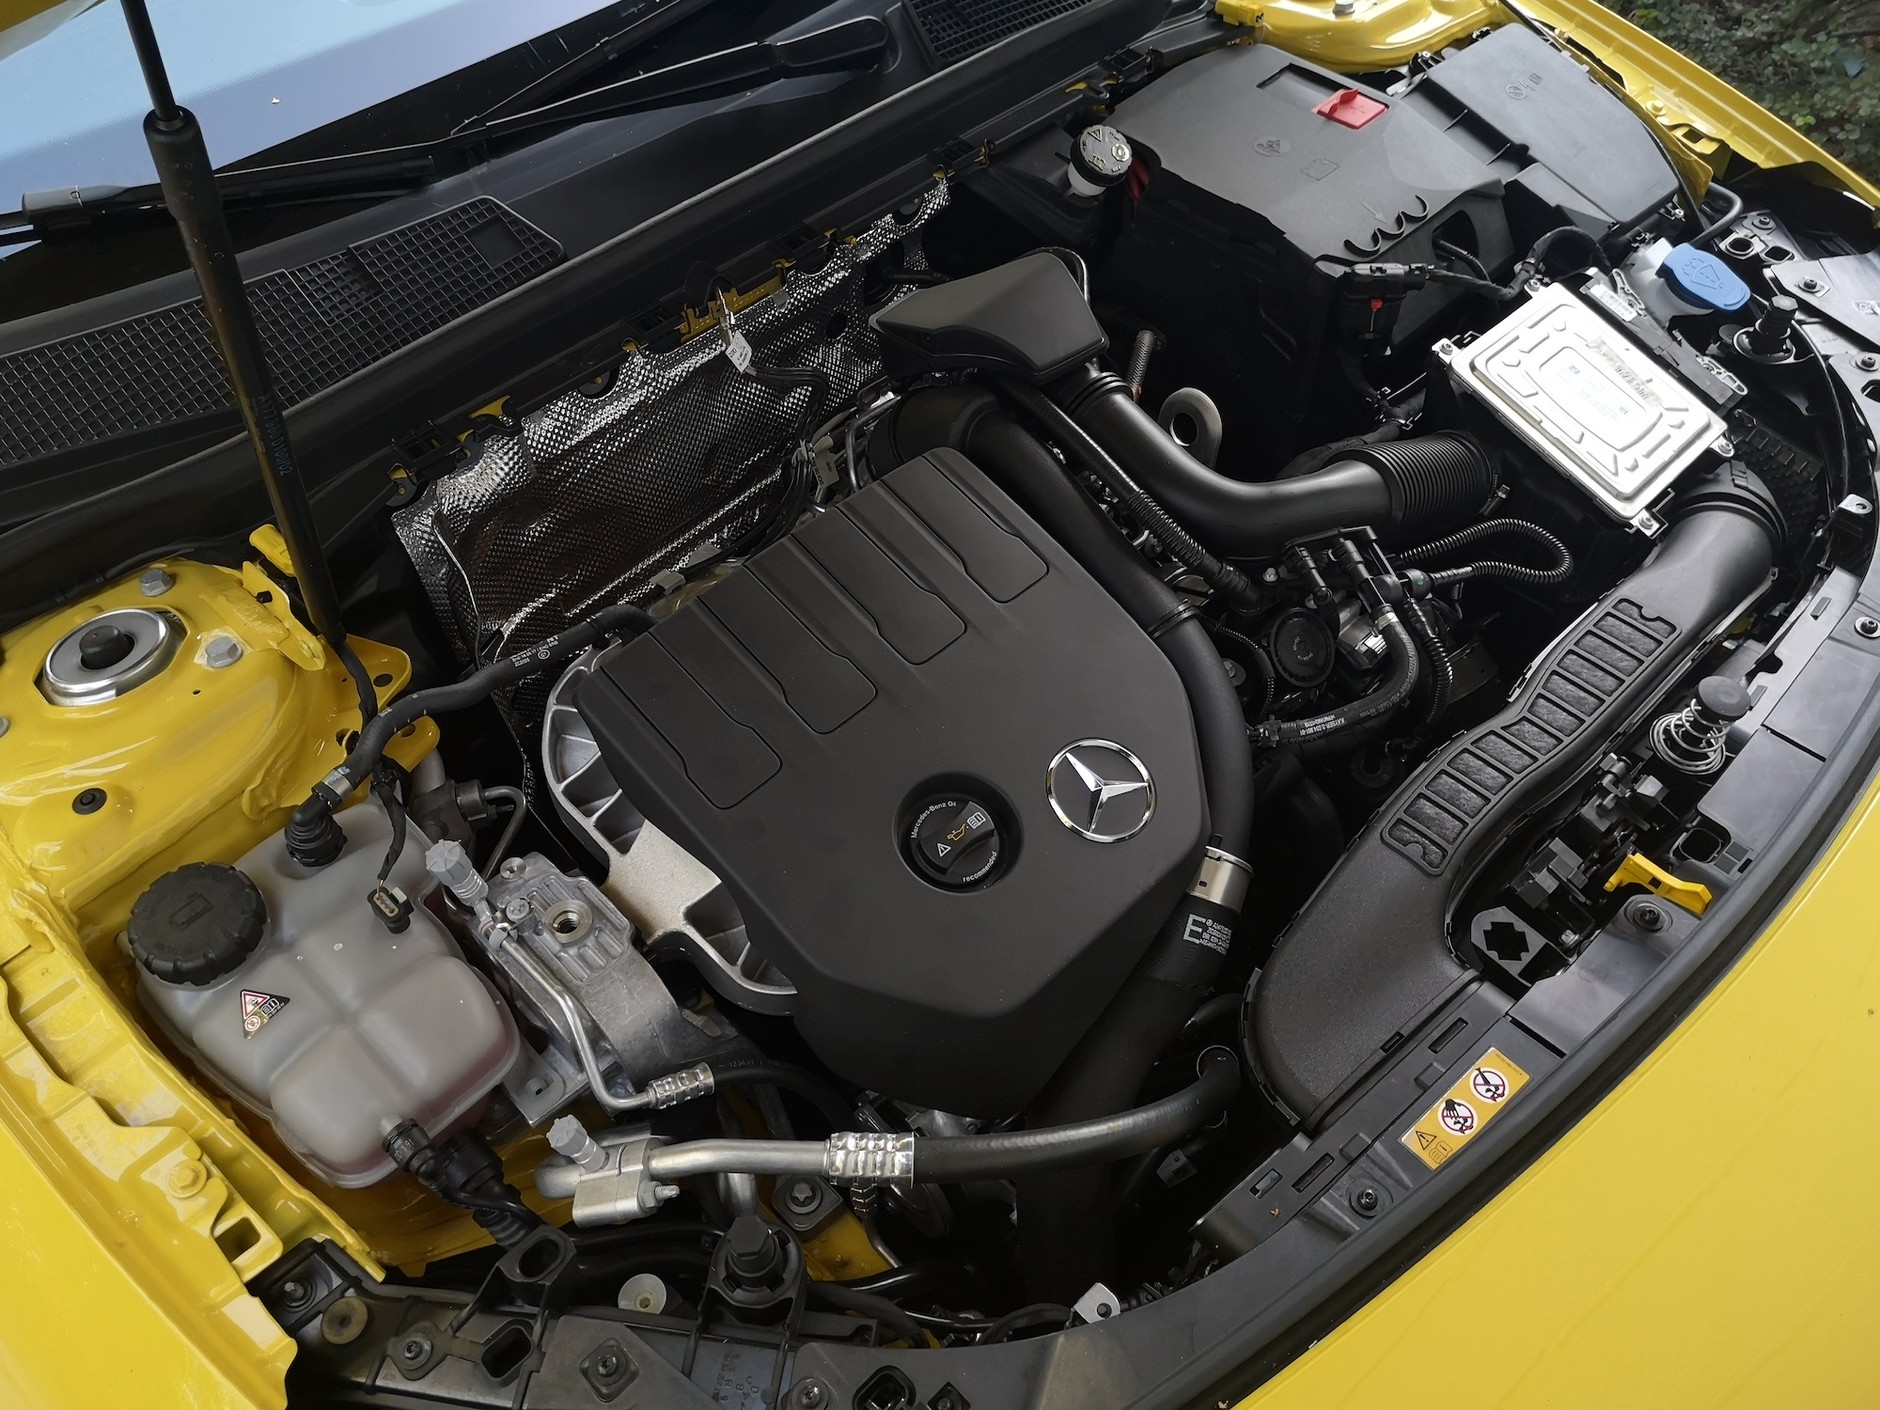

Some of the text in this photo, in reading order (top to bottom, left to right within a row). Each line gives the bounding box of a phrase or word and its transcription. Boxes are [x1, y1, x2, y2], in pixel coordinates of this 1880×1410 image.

[911, 803, 946, 838] Mercedes-Benz
[963, 851, 997, 882] recommended
[1183, 914, 1206, 944] E
